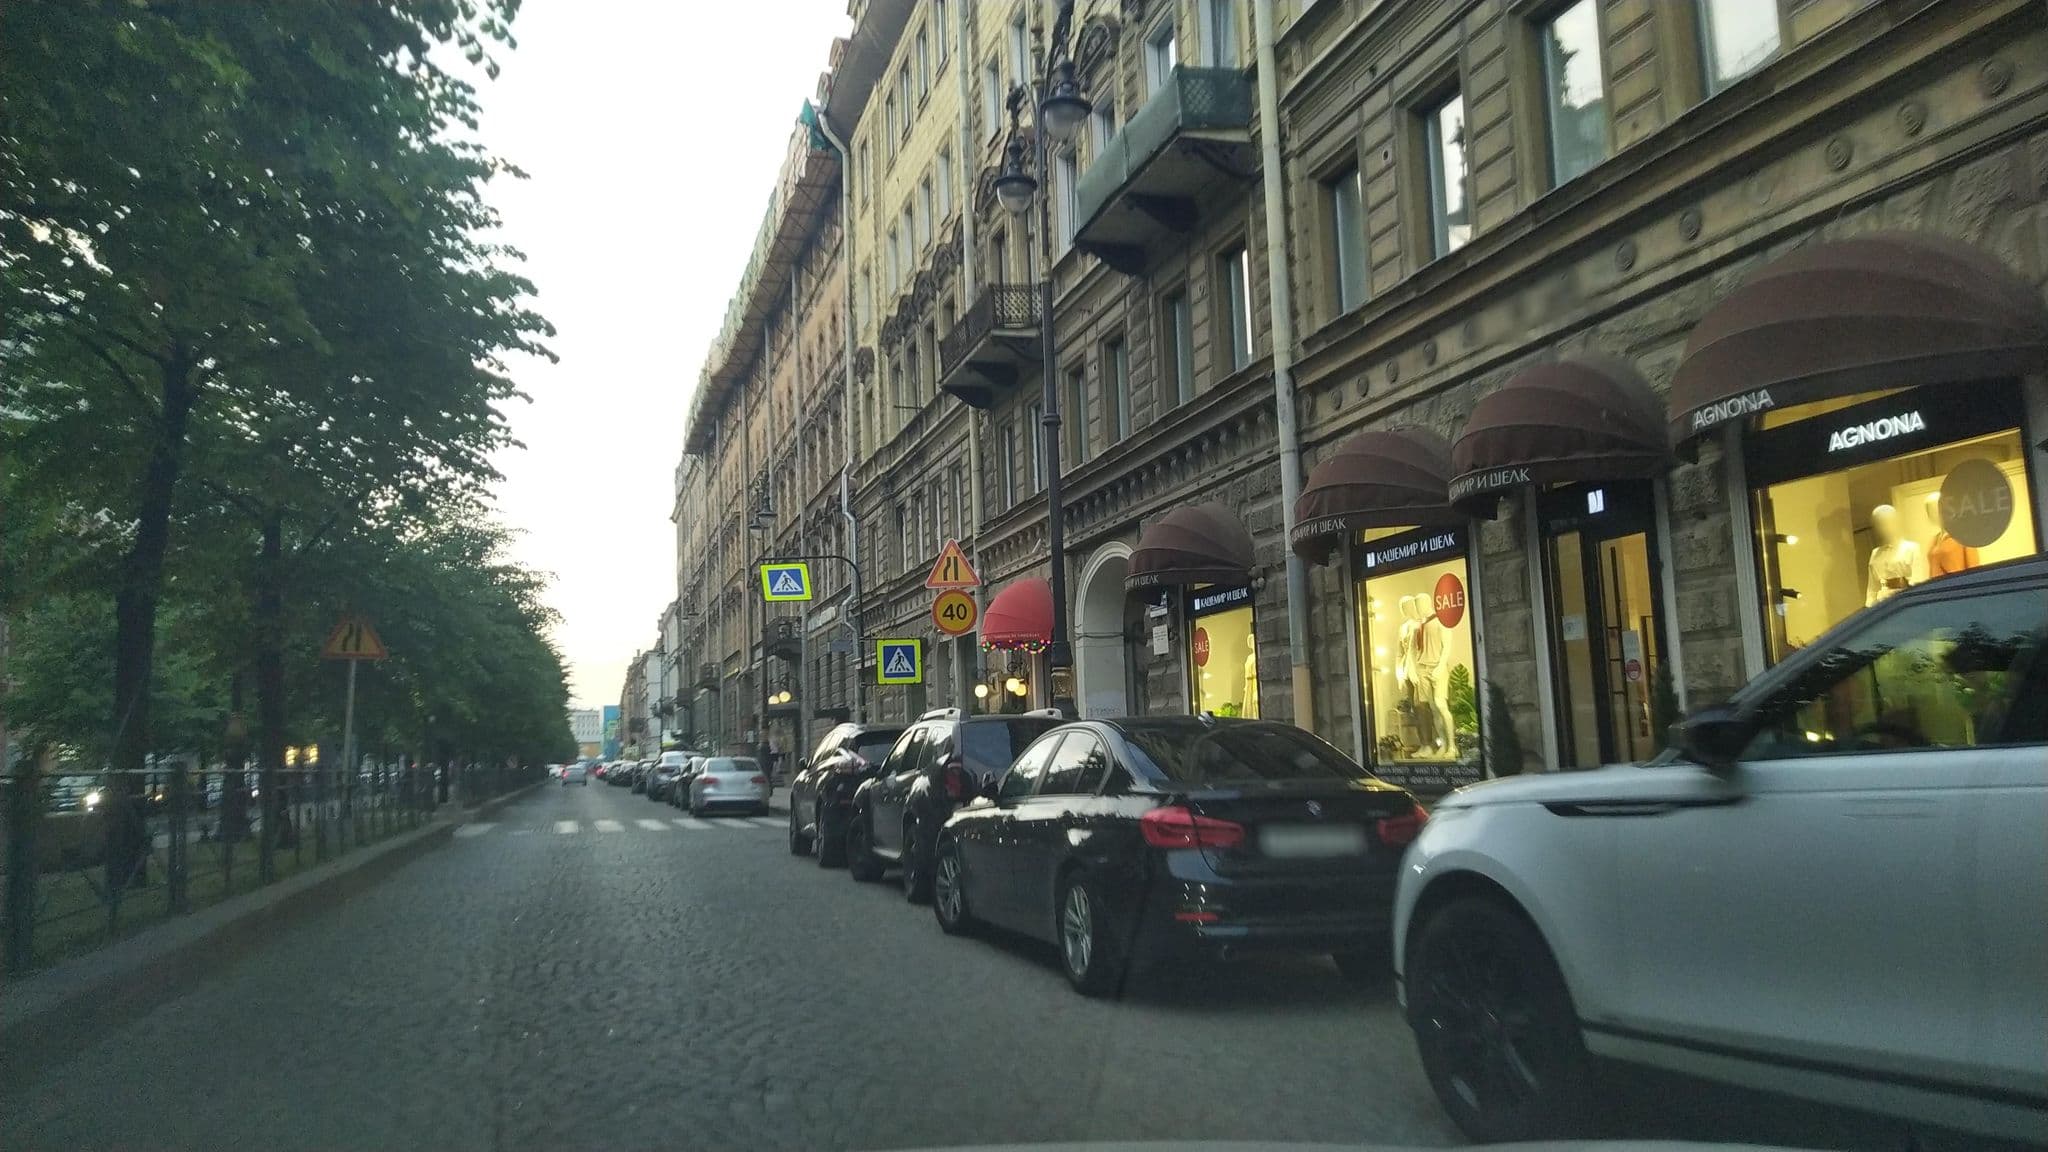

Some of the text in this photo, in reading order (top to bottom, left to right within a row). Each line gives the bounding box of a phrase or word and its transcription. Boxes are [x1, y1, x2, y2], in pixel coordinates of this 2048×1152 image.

[1692, 388, 1774, 430] AGNONA
[1828, 410, 1926, 452] AGNONA
[1477, 475, 1487, 489] И
[1490, 468, 1530, 487] ШЕЛК
[1942, 486, 2010, 520] SALE
[1319, 517, 1346, 533] ШЕЛК
[1376, 532, 1455, 565] КАШЕМИР И ШЕЛК
[1435, 590, 1464, 611] SALE
[942, 603, 968, 621] 40
[1194, 640, 1209, 655] SALE
